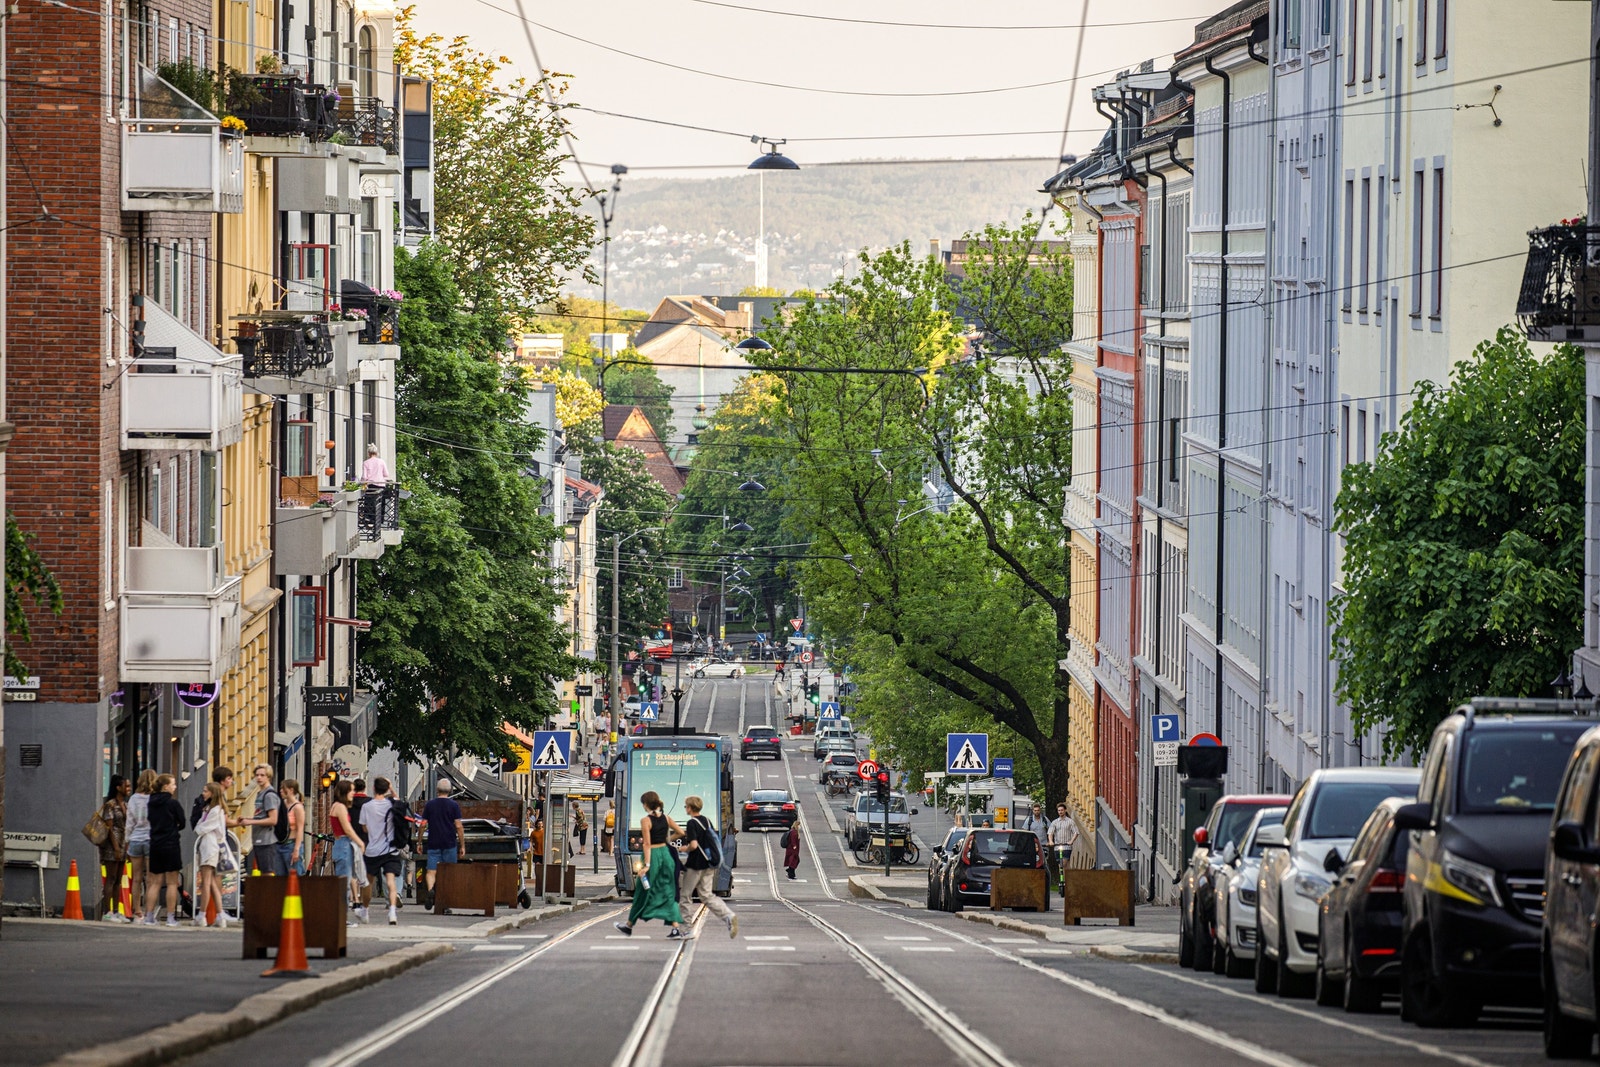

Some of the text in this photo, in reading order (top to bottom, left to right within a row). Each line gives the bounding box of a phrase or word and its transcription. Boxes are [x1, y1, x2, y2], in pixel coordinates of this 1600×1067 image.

[312, 693, 348, 702] DJERV
[1158, 718, 1172, 738] P
[640, 753, 650, 766] 17
[862, 765, 874, 774] 40
